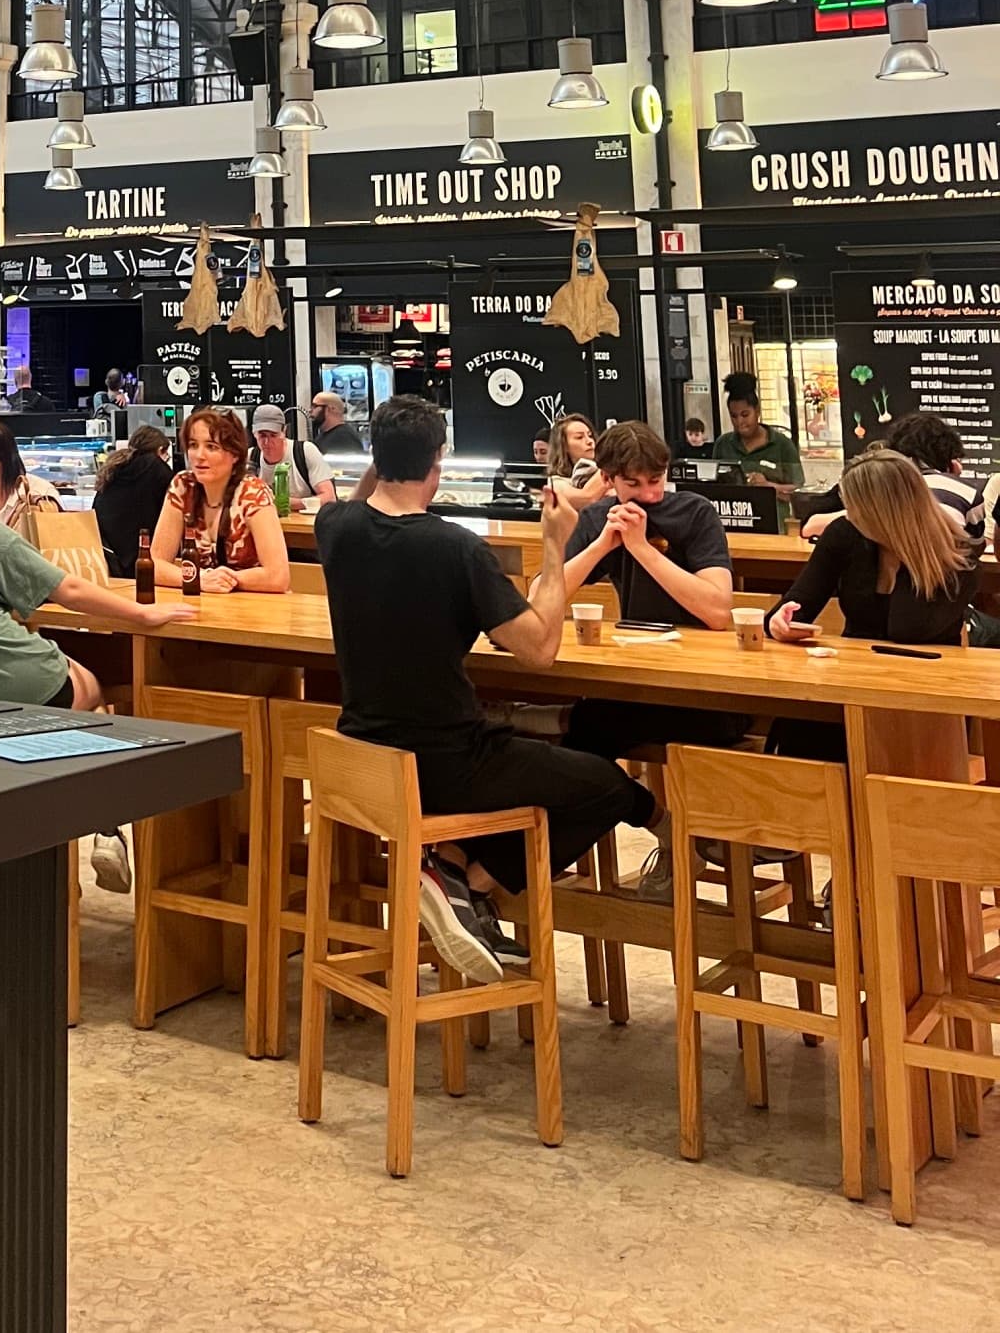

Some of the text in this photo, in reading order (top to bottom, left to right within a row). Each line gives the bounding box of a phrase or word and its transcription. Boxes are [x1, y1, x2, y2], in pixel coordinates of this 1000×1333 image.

[751, 141, 1000, 192] CRUSH DOUGHN
[370, 164, 562, 207] TIME OUT SHOP
[84, 186, 167, 220] TARTINE
[872, 284, 947, 305] MERCADO
[952, 284, 975, 304] DA
[471, 295, 511, 313] TERRA
[515, 295, 531, 313] DO
[873, 329, 894, 344] SOUP
[895, 329, 933, 345] MARQUET
[939, 329, 950, 344] LA
[950, 329, 977, 344] SOUPE
[978, 329, 990, 344] DU
[156, 342, 201, 357] PASTÉIS
[465, 349, 545, 372] PETISCARIA
[598, 368, 618, 380] 3.90
[268, 394, 286, 404] 0.50
[720, 500, 731, 516] DA
[732, 501, 753, 517] SOPA
